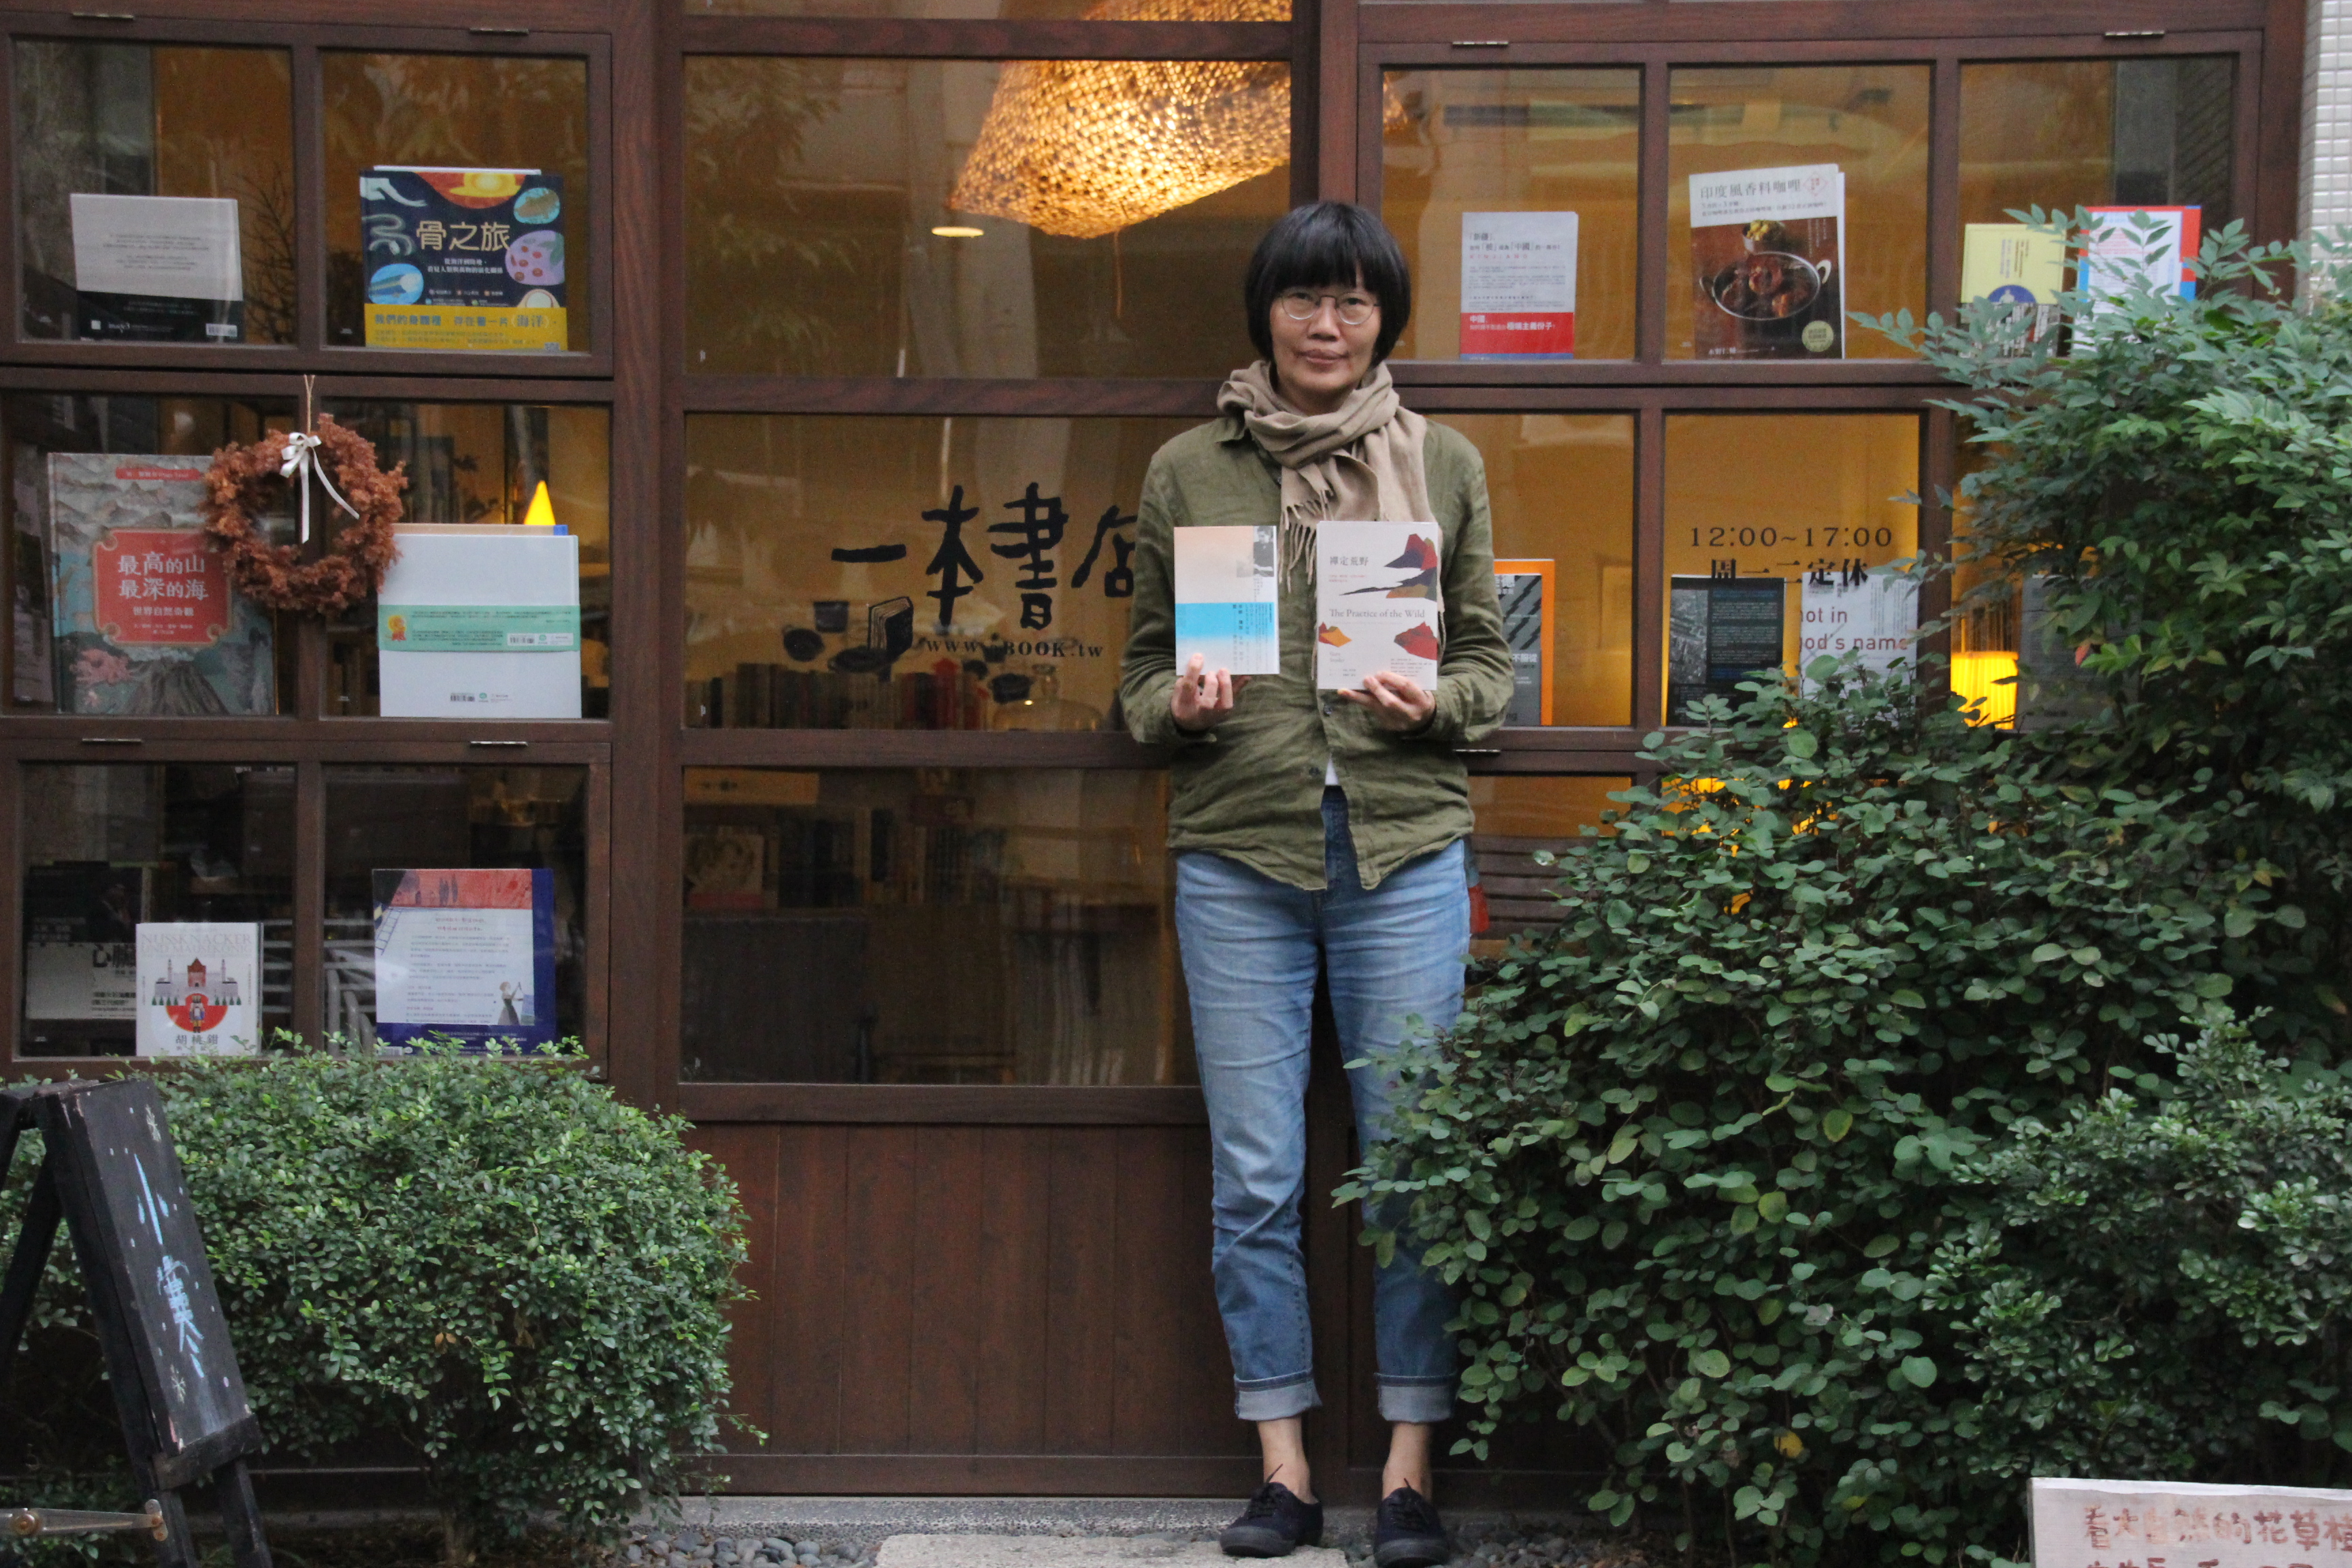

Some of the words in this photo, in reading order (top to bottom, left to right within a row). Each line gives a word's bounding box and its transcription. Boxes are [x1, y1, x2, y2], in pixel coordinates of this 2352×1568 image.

[416, 220, 510, 251] 骨之旅
[1692, 527, 1892, 547] 12:00~17:00
[118, 551, 205, 576] 最高的山
[831, 482, 1139, 636] 一本書店
[118, 578, 209, 601] 最深的海
[1329, 609, 1344, 618] The
[1347, 609, 1377, 618] Practice
[1379, 609, 1388, 618] of
[1390, 609, 1403, 618] the
[1405, 609, 1425, 618] Wild
[1831, 607, 1847, 623] in
[1854, 638, 1908, 650] name
